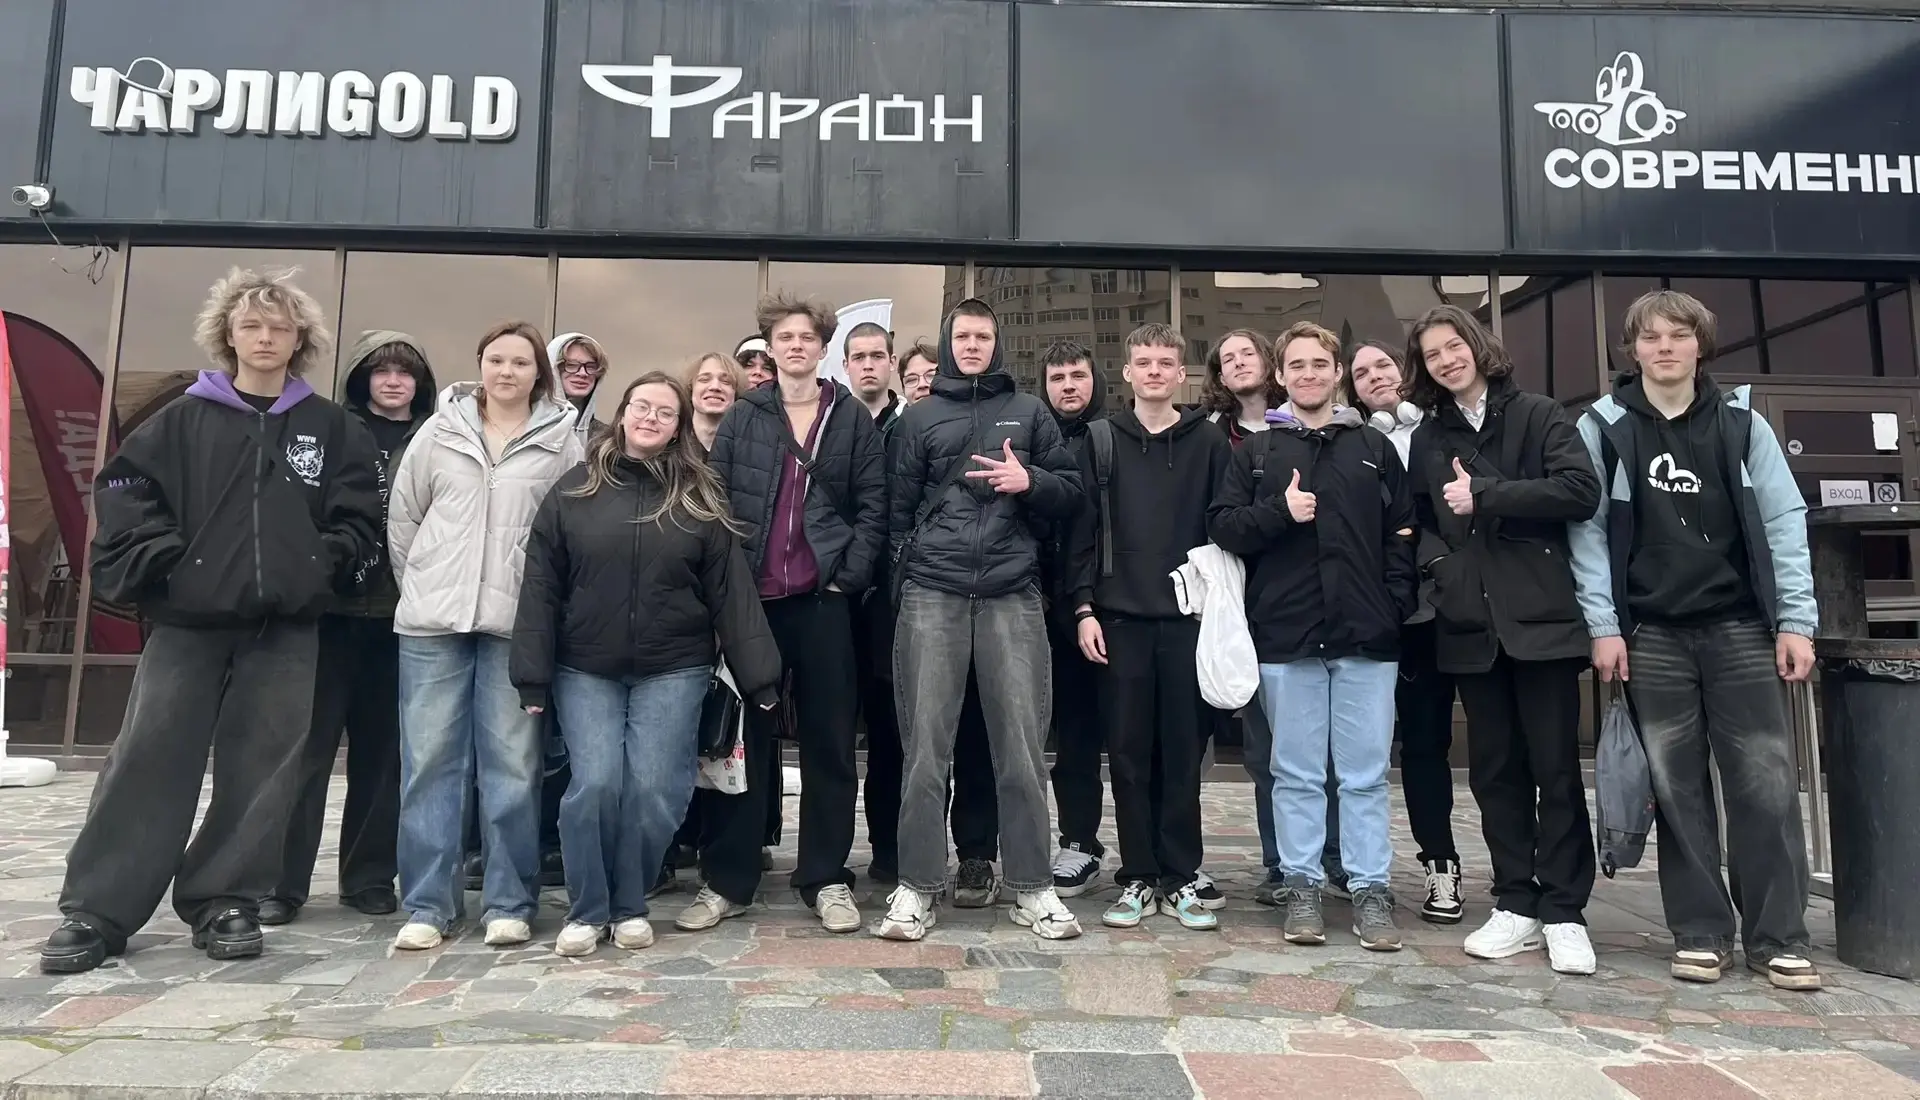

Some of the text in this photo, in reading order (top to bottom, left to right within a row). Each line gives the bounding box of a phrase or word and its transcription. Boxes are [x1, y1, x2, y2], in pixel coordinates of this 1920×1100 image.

[581, 54, 983, 142] ФАРАОН
[1544, 147, 1920, 194] СОВРЕМЕНН
[296, 434, 317, 444] WWW
[1829, 488, 1863, 501] ВХОД
